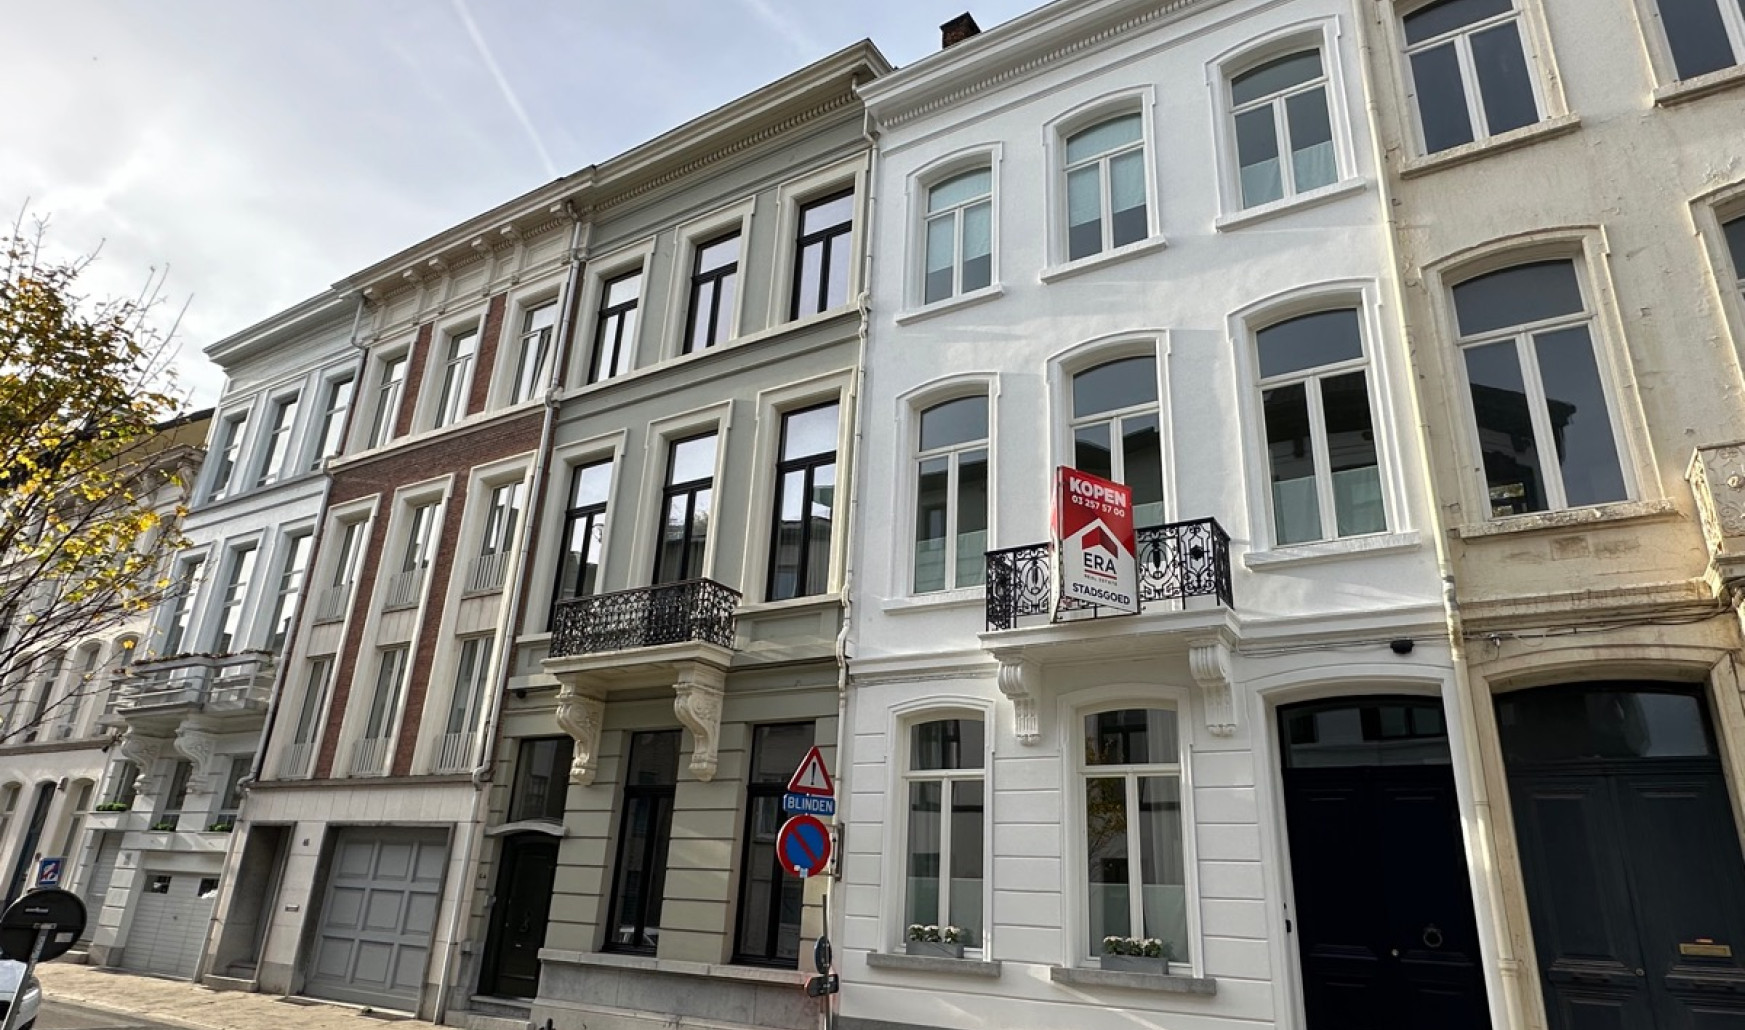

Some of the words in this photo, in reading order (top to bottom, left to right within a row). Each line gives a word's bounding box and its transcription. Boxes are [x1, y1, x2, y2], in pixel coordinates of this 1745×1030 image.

[1069, 476, 1126, 507] KOPEN
[1072, 495, 1083, 505] 03
[1085, 499, 1099, 510] 257
[1102, 504, 1112, 513] 57
[1113, 508, 1125, 517] 00
[1084, 552, 1117, 575] ERA
[1072, 582, 1131, 604] STADSGOED
[787, 797, 833, 813] BLINDEN
